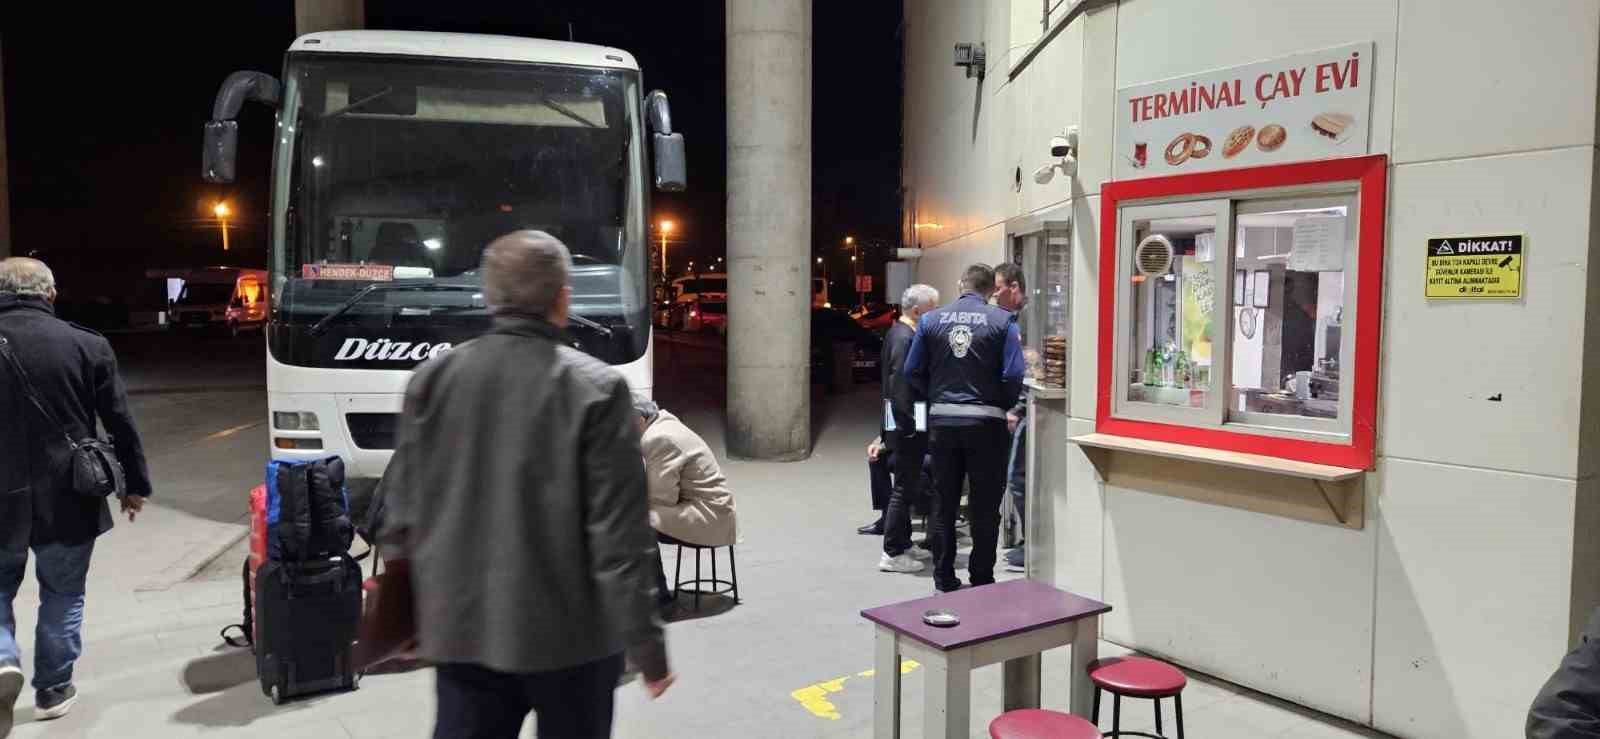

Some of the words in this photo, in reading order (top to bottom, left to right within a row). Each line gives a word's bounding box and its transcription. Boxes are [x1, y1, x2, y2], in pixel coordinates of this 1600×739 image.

[1129, 79, 1246, 123] TERMİNAL
[1255, 67, 1307, 109] ÇAY
[1315, 51, 1359, 93] EVİ
[1458, 240, 1513, 253] DİKKAT!
[939, 312, 988, 325] ZABITA
[334, 338, 452, 360] Düzce
